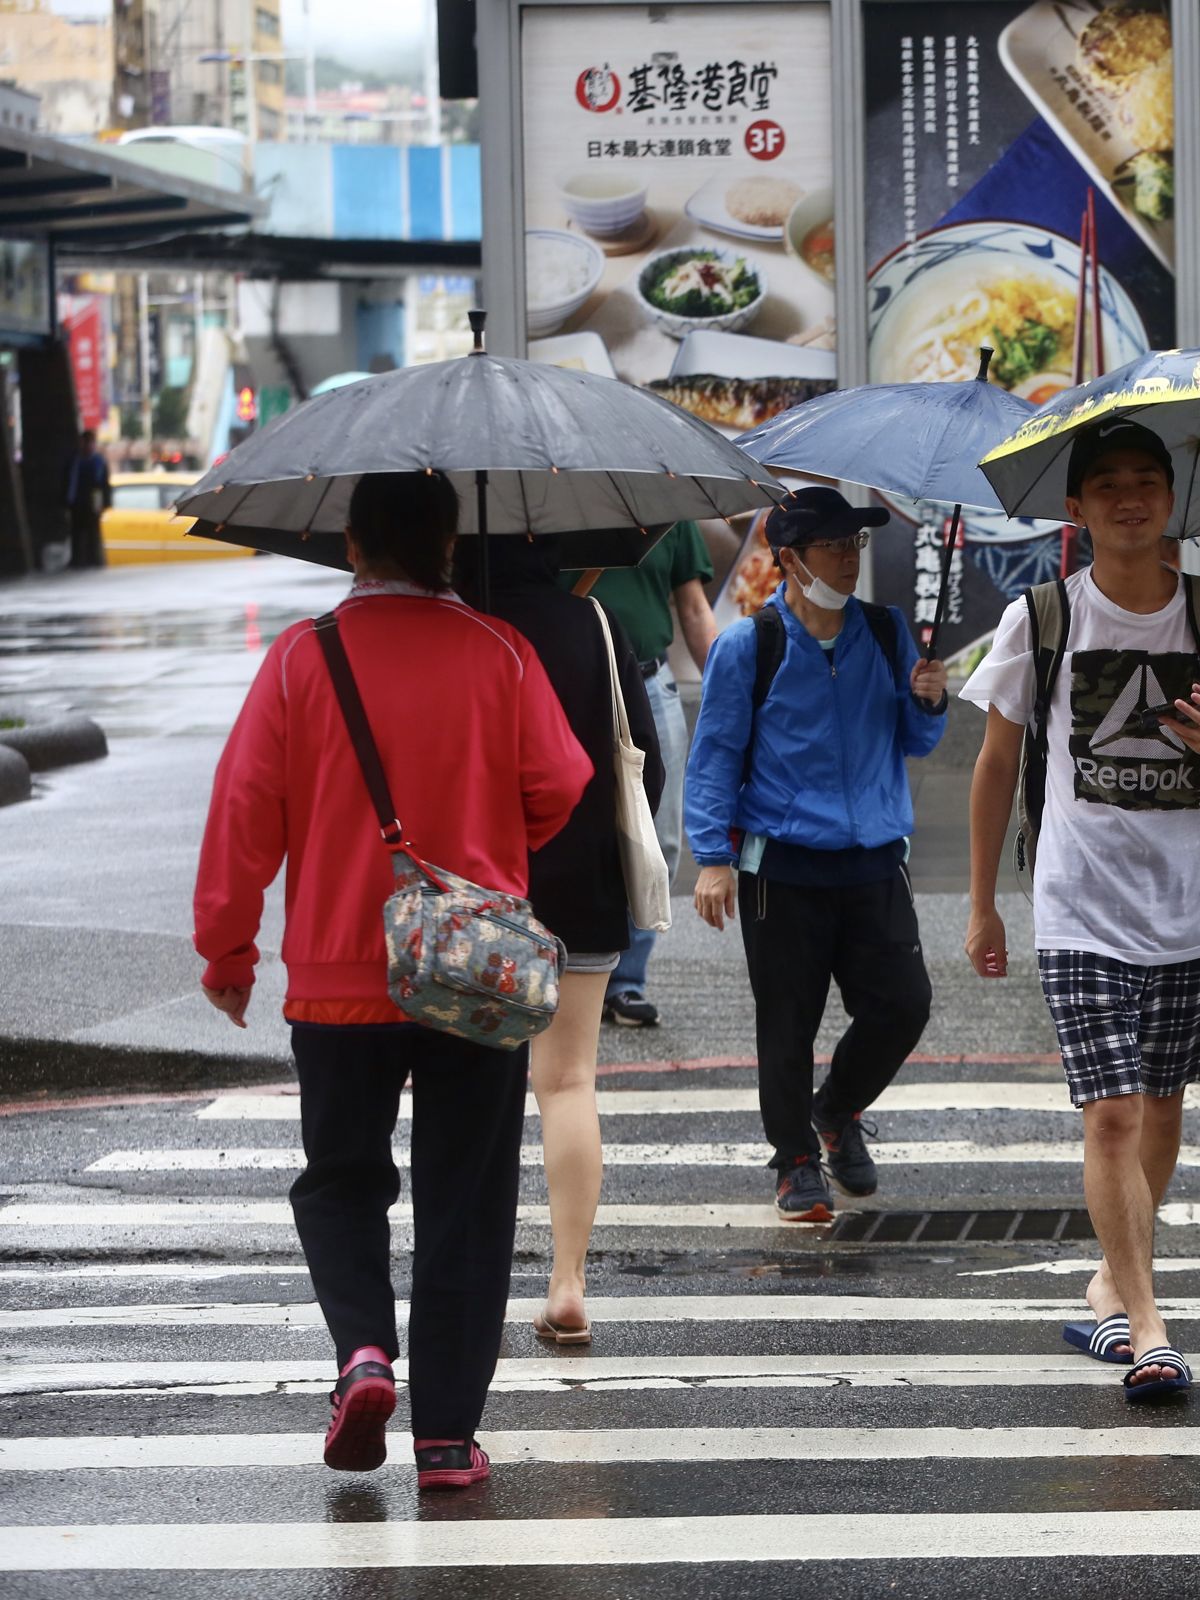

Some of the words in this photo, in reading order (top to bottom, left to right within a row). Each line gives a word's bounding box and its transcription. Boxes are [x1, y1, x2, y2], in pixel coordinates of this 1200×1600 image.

[626, 60, 778, 113] 基隆港食堂
[587, 138, 733, 159] 日本最大連鎖食堂
[749, 128, 782, 154] 3F
[1076, 757, 1194, 792] Reebok
